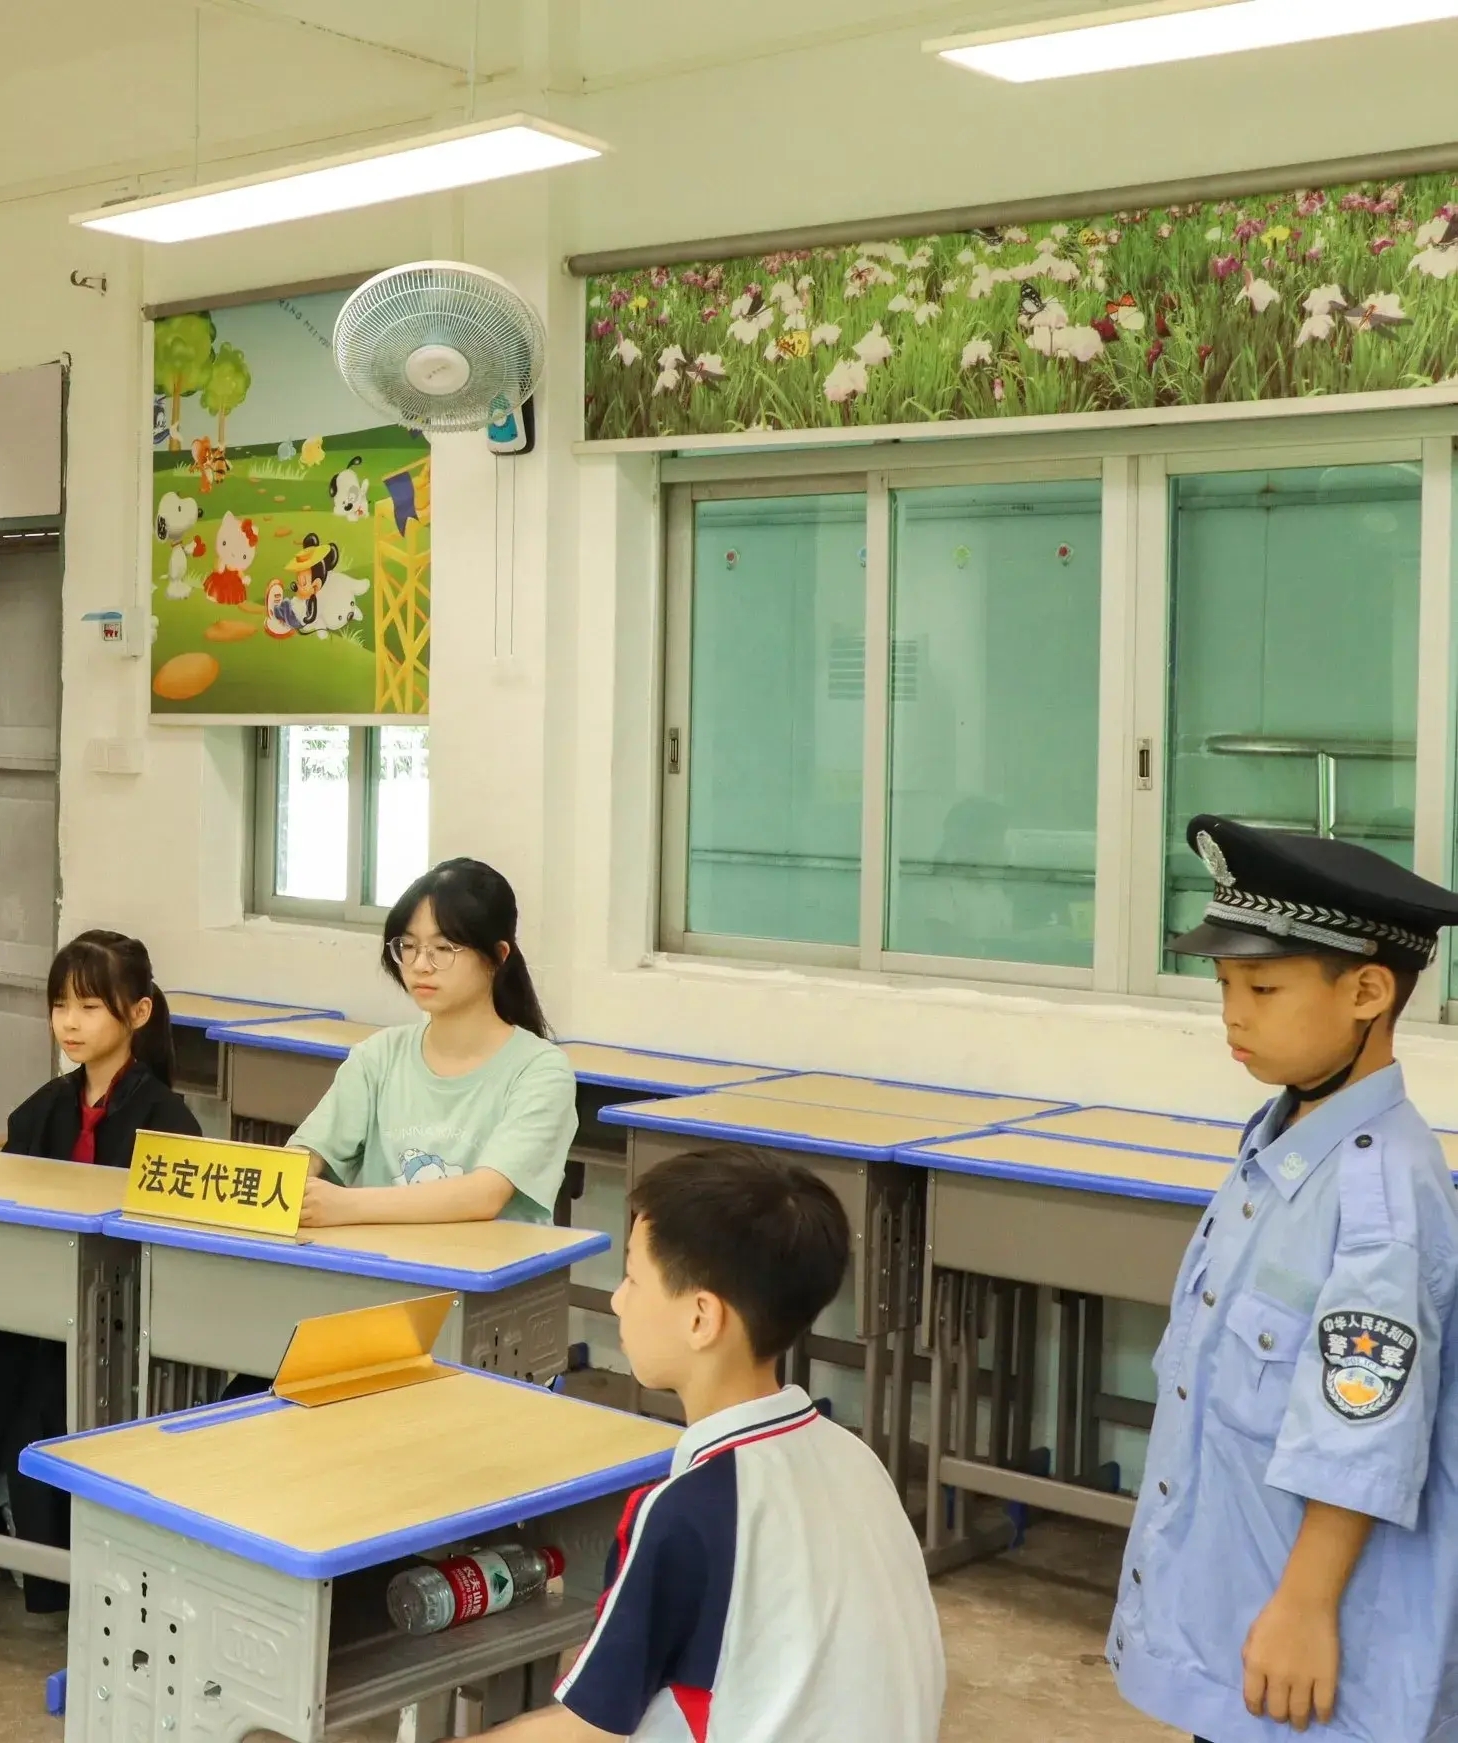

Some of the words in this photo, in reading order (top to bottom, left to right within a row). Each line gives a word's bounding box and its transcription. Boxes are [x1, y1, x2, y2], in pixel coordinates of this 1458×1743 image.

[137, 1153, 291, 1213] 法定代理人
[1322, 1314, 1415, 1350] 中华人民共和国
